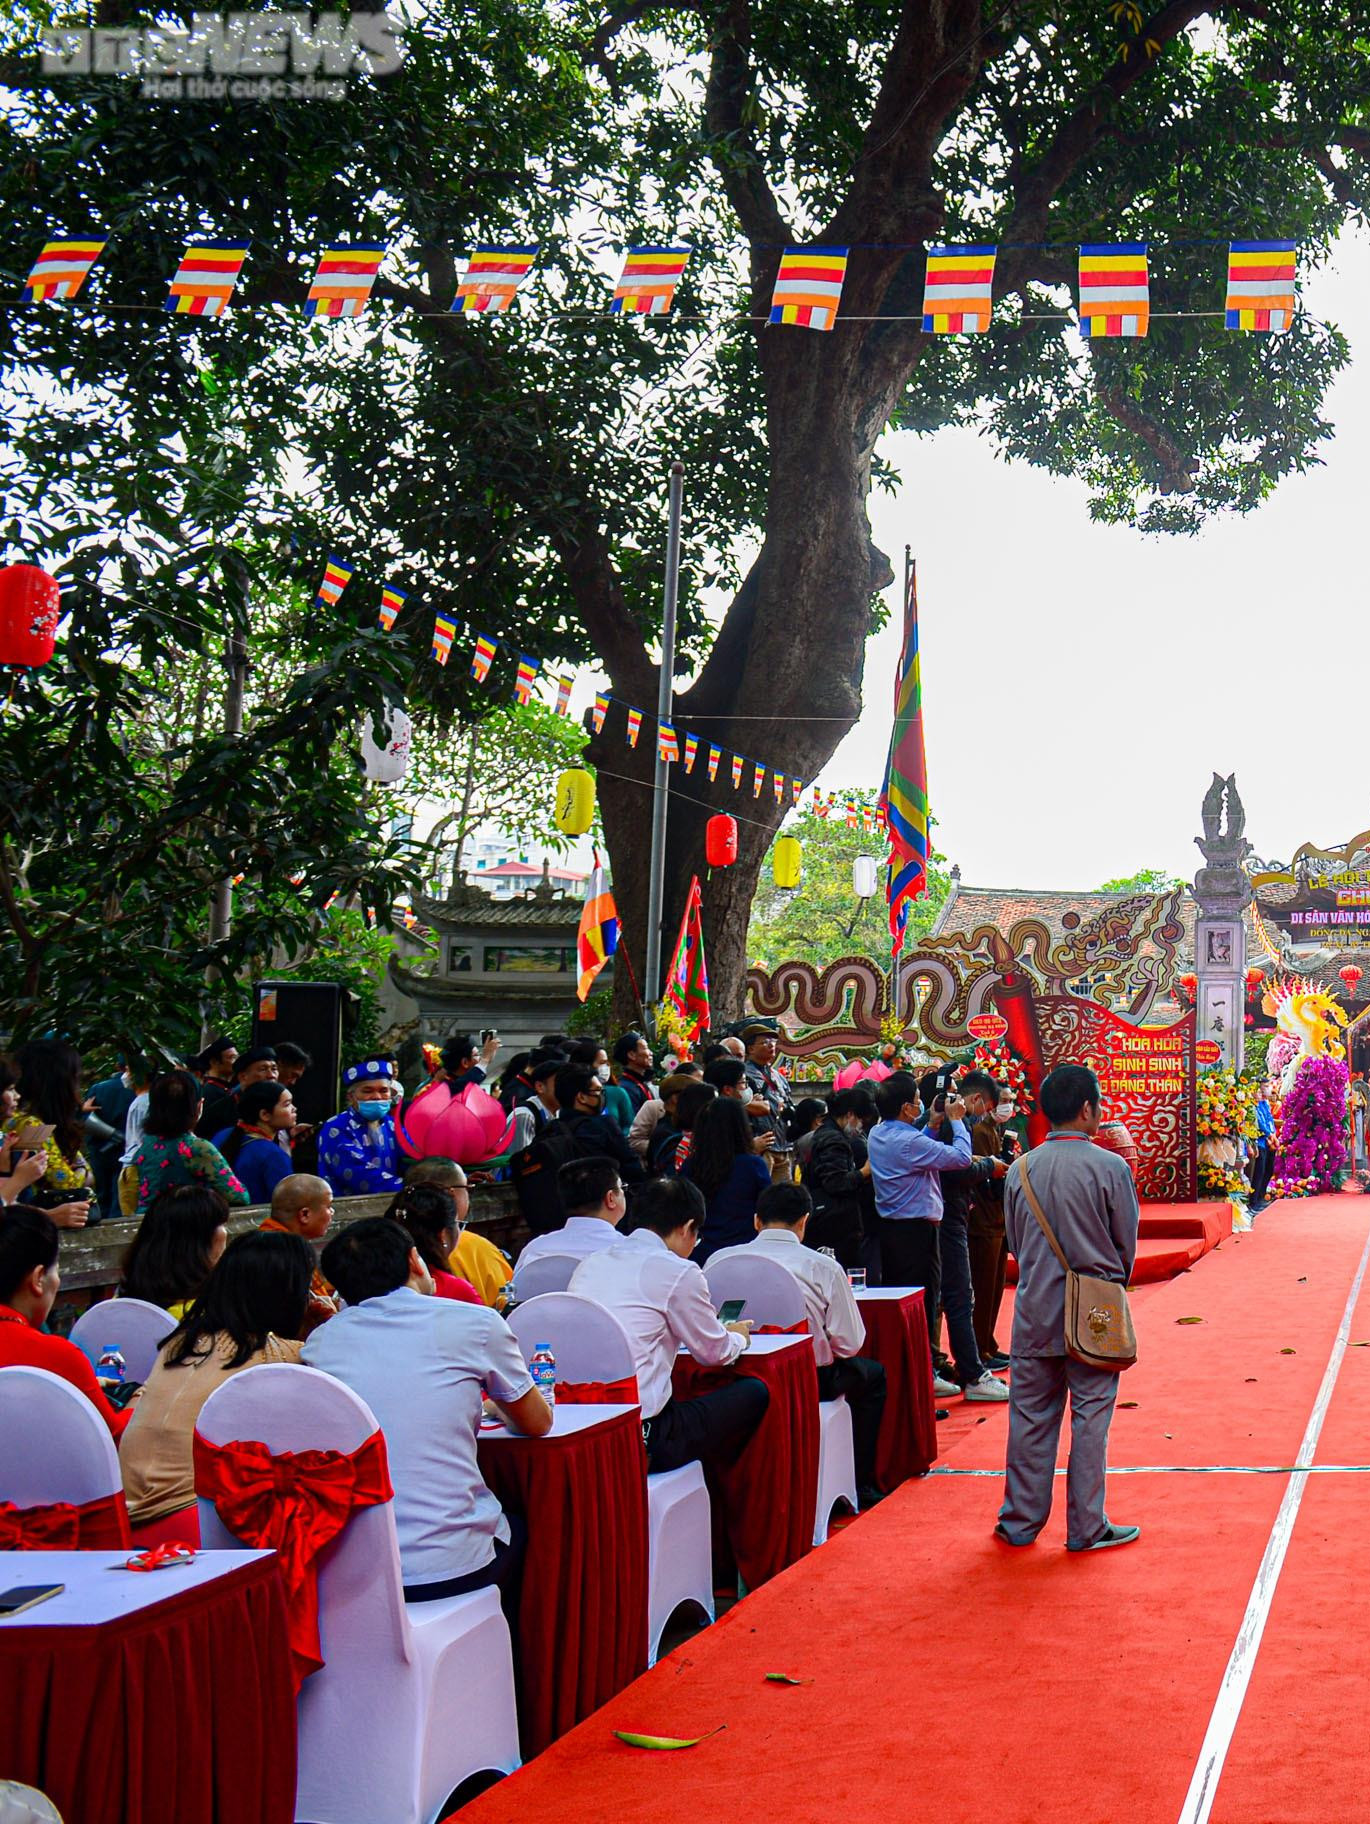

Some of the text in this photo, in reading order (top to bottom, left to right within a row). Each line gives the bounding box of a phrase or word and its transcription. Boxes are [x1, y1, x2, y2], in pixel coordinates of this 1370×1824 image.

[1290, 911, 1304, 924] DI
[1305, 909, 1329, 924] SẢN
[1330, 909, 1355, 924] VĂN
[1112, 1057, 1182, 1071] SINH SINH
